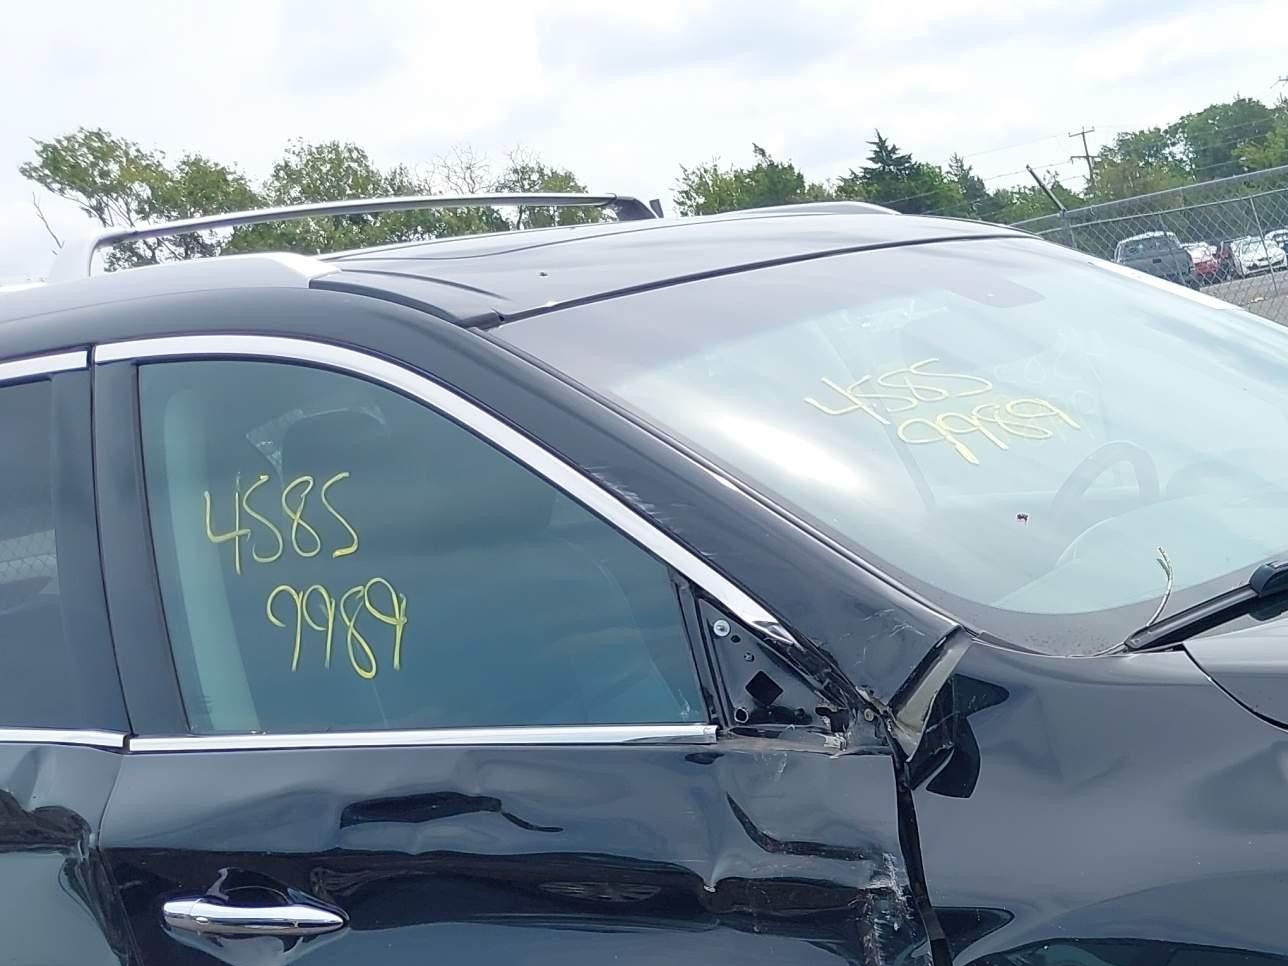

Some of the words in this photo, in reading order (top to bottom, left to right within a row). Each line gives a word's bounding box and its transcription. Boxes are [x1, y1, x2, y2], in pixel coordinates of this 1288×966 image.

[803, 357, 993, 426] 4585
[896, 397, 1081, 466] 9989
[203, 471, 359, 576] 4585
[265, 576, 408, 680] 9989
